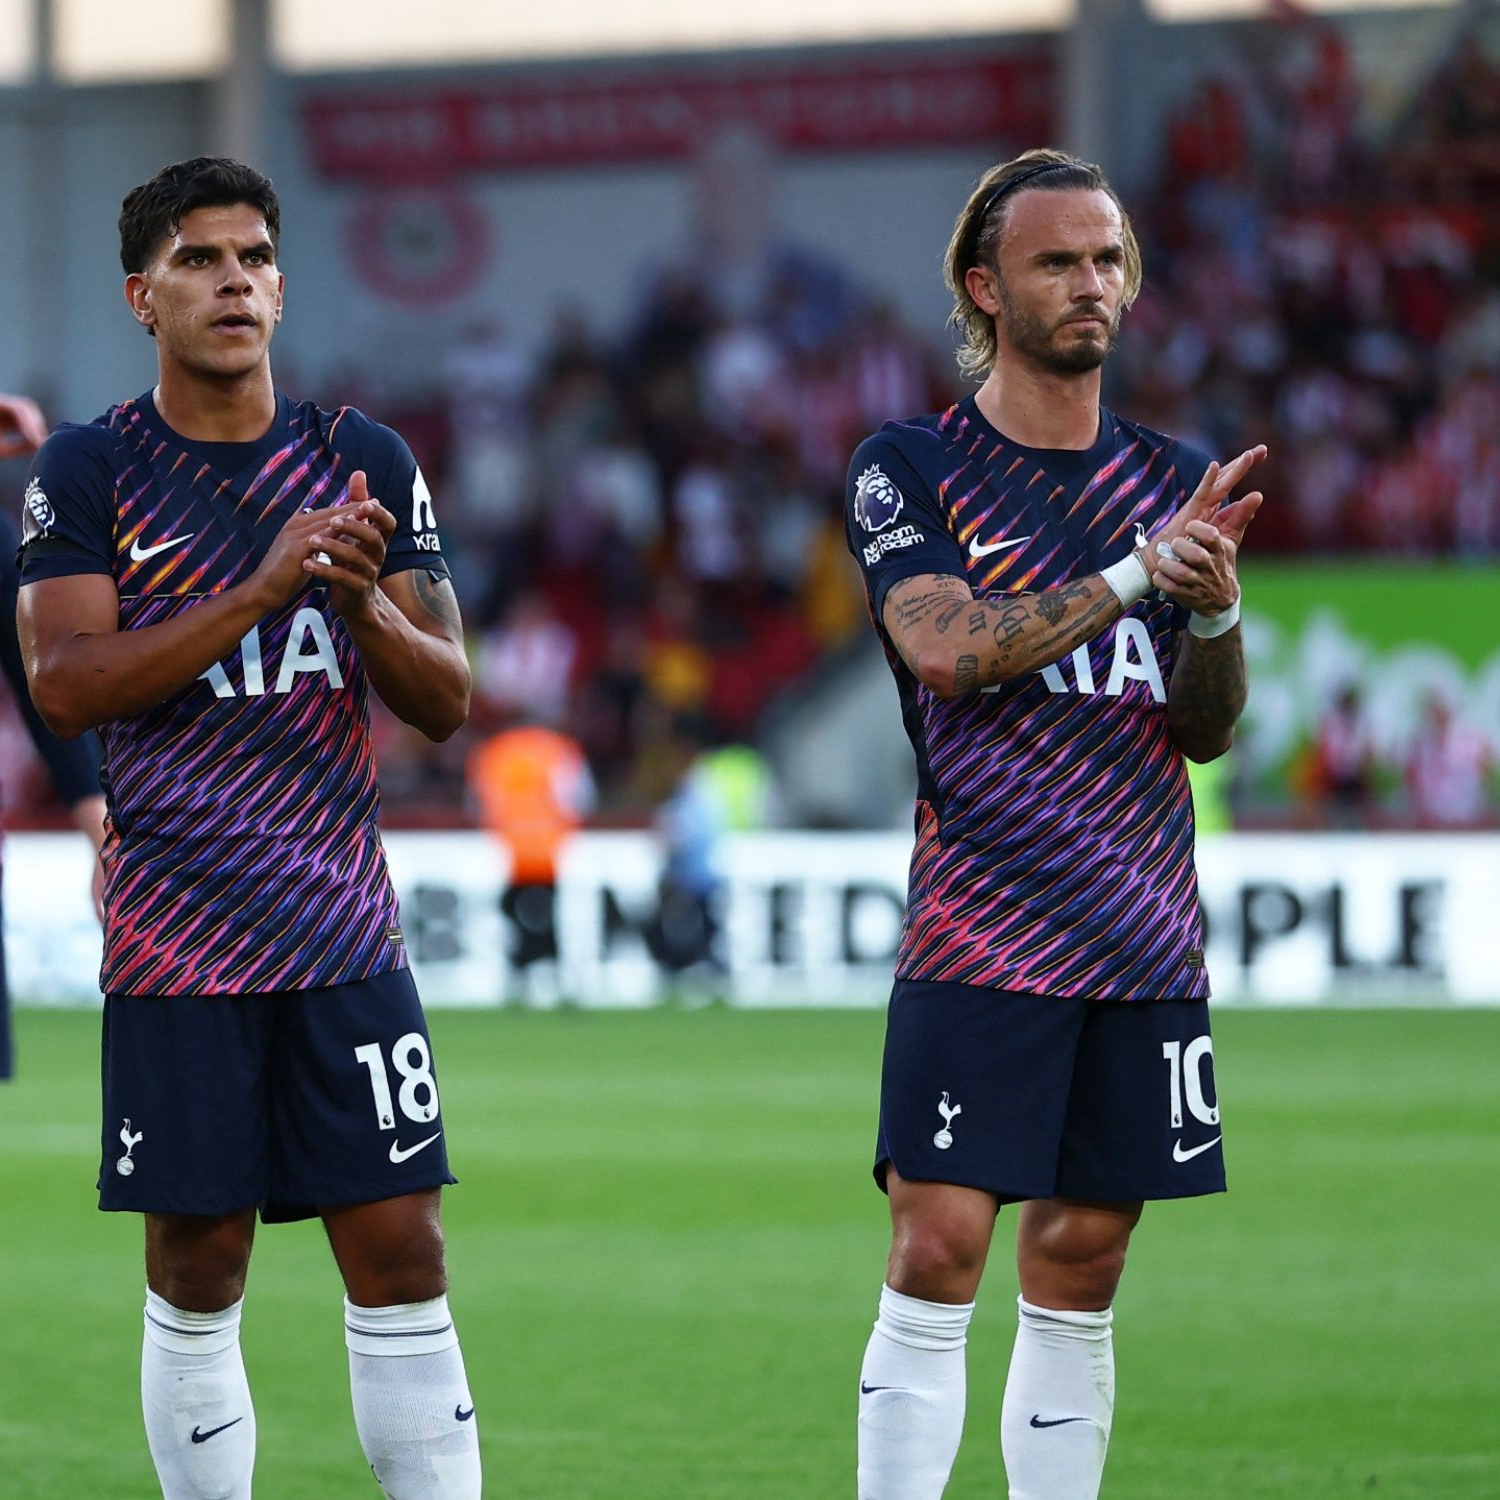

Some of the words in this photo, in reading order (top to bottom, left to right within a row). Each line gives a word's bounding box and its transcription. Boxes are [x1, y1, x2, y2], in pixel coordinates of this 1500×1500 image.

[877, 525, 915, 544] room
[880, 533, 925, 554] racism
[354, 1032, 439, 1131] 18
[1162, 1035, 1220, 1129] 10
